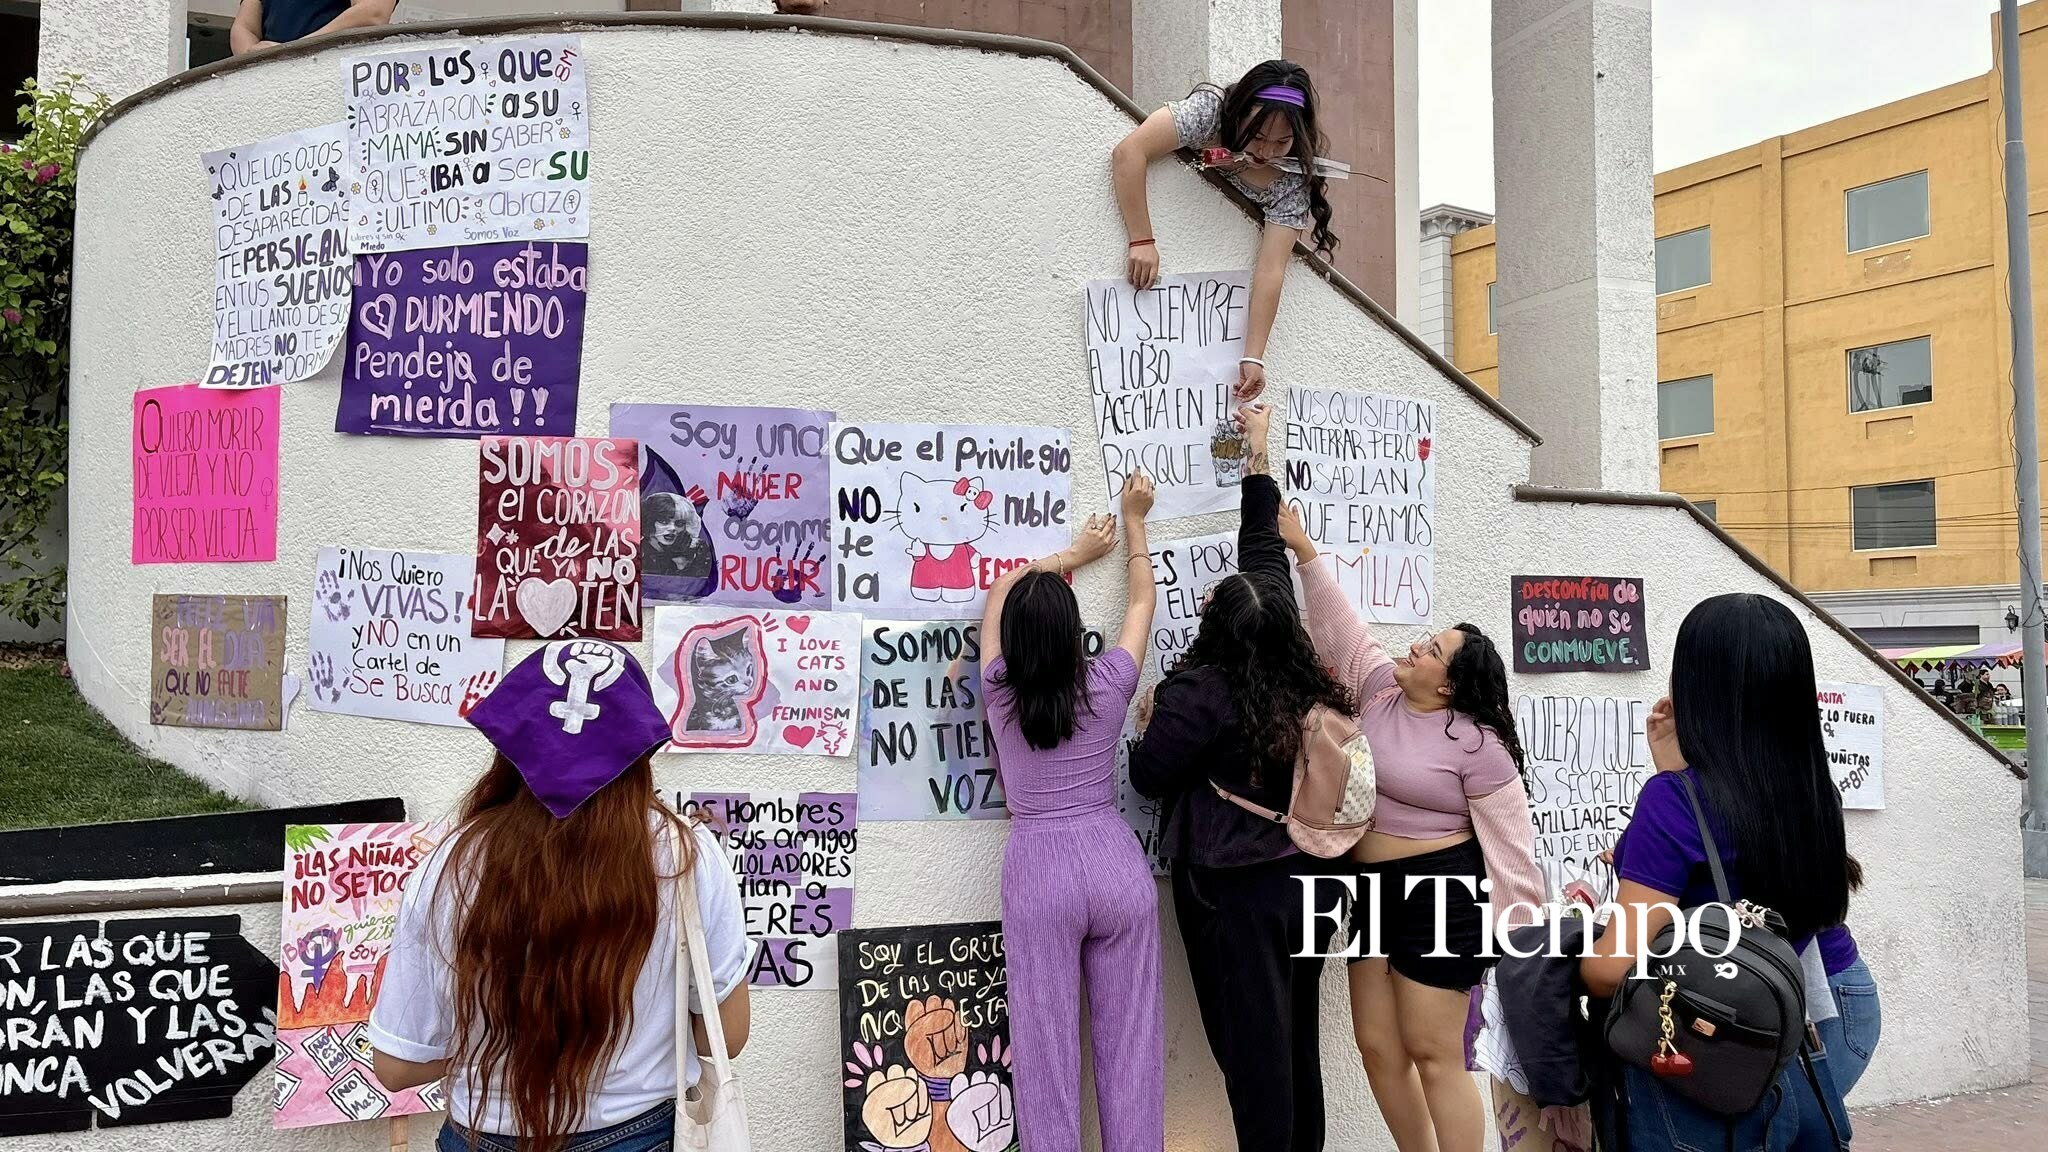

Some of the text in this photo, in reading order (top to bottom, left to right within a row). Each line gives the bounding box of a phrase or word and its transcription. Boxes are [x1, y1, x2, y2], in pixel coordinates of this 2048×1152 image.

[353, 62, 409, 96] POR
[357, 94, 487, 137] ABRAZARON
[445, 129, 487, 156] SIN
[491, 122, 554, 152] SABER
[220, 141, 342, 191] QUE LOS OJOS
[365, 166, 417, 204] QUE
[431, 164, 463, 192] IBA
[547, 151, 588, 180] SU
[229, 181, 292, 221] DE LAS
[219, 229, 348, 280] TE PERSIGAN
[422, 241, 587, 293] solo estaba
[216, 285, 236, 311] EN
[238, 279, 269, 307] TUS
[1087, 279, 1245, 346] NO SIEMPRE
[228, 310, 246, 337] EL
[251, 306, 301, 333] LLANTO
[308, 303, 327, 326] DE
[405, 290, 564, 339] DURMIENDO
[214, 330, 322, 362] MADRES NO TE
[492, 340, 533, 384] de
[207, 360, 272, 386] DEJEN
[1089, 349, 1111, 395] EL
[208, 407, 263, 451] MORIR
[1101, 389, 1169, 438] ACECHA
[1176, 387, 1203, 430] EN
[1290, 388, 1431, 434] NOS QUISIERON
[670, 412, 824, 460] Soy una
[836, 427, 902, 466] Que
[917, 431, 943, 462] el
[1287, 423, 1416, 462] ENTERRAR PERO
[138, 455, 153, 499] DE
[206, 454, 218, 496] Y
[224, 451, 253, 496] NO
[483, 437, 619, 490] SOMOS
[1102, 443, 1203, 501] BOSQUE
[1287, 459, 1311, 491] NO
[498, 487, 525, 522] el
[717, 471, 802, 500] MUJER
[839, 486, 1066, 527] NO nuble
[1348, 504, 1432, 546] ERAMOS
[140, 507, 168, 560] POR
[168, 507, 197, 560] SER
[535, 526, 637, 560] de LAS
[838, 526, 874, 559] te
[391, 552, 443, 586] Quiero
[496, 547, 635, 585] QUE YA NO
[721, 554, 821, 594] RUGIR
[1190, 541, 1239, 577] POR
[837, 563, 880, 602] la
[1613, 579, 1639, 604] de
[367, 619, 399, 647] NO
[407, 633, 430, 650] en
[437, 634, 461, 652] un
[1519, 602, 1603, 635] quién no
[352, 648, 440, 676] Cartel de
[777, 638, 841, 652] I LOVE
[797, 655, 845, 670] CATS
[871, 626, 980, 665] SOMOS
[166, 669, 190, 696] QUE
[196, 669, 210, 696] NO
[795, 679, 838, 692] AND
[873, 676, 975, 710] DE LAS
[772, 706, 850, 721] FEMINISM
[1828, 709, 1874, 725] LO FUERA
[871, 721, 917, 766] NO
[1516, 695, 1645, 774] QUIERO QUE
[929, 768, 1006, 814] VOZ
[726, 798, 844, 825] Hombres
[729, 829, 767, 850] sus
[774, 828, 857, 854] amigos
[1562, 834, 1582, 855] DE
[292, 872, 367, 912] NO SE
[40, 931, 211, 971] LAS QUE
[917, 942, 944, 965] EL
[56, 964, 233, 1010] LAS QUE
[856, 969, 978, 1007] DE LAS QUE
[126, 1000, 246, 1044] Y LAS
[860, 1010, 903, 1043] NO
[338, 1080, 358, 1098] NO
